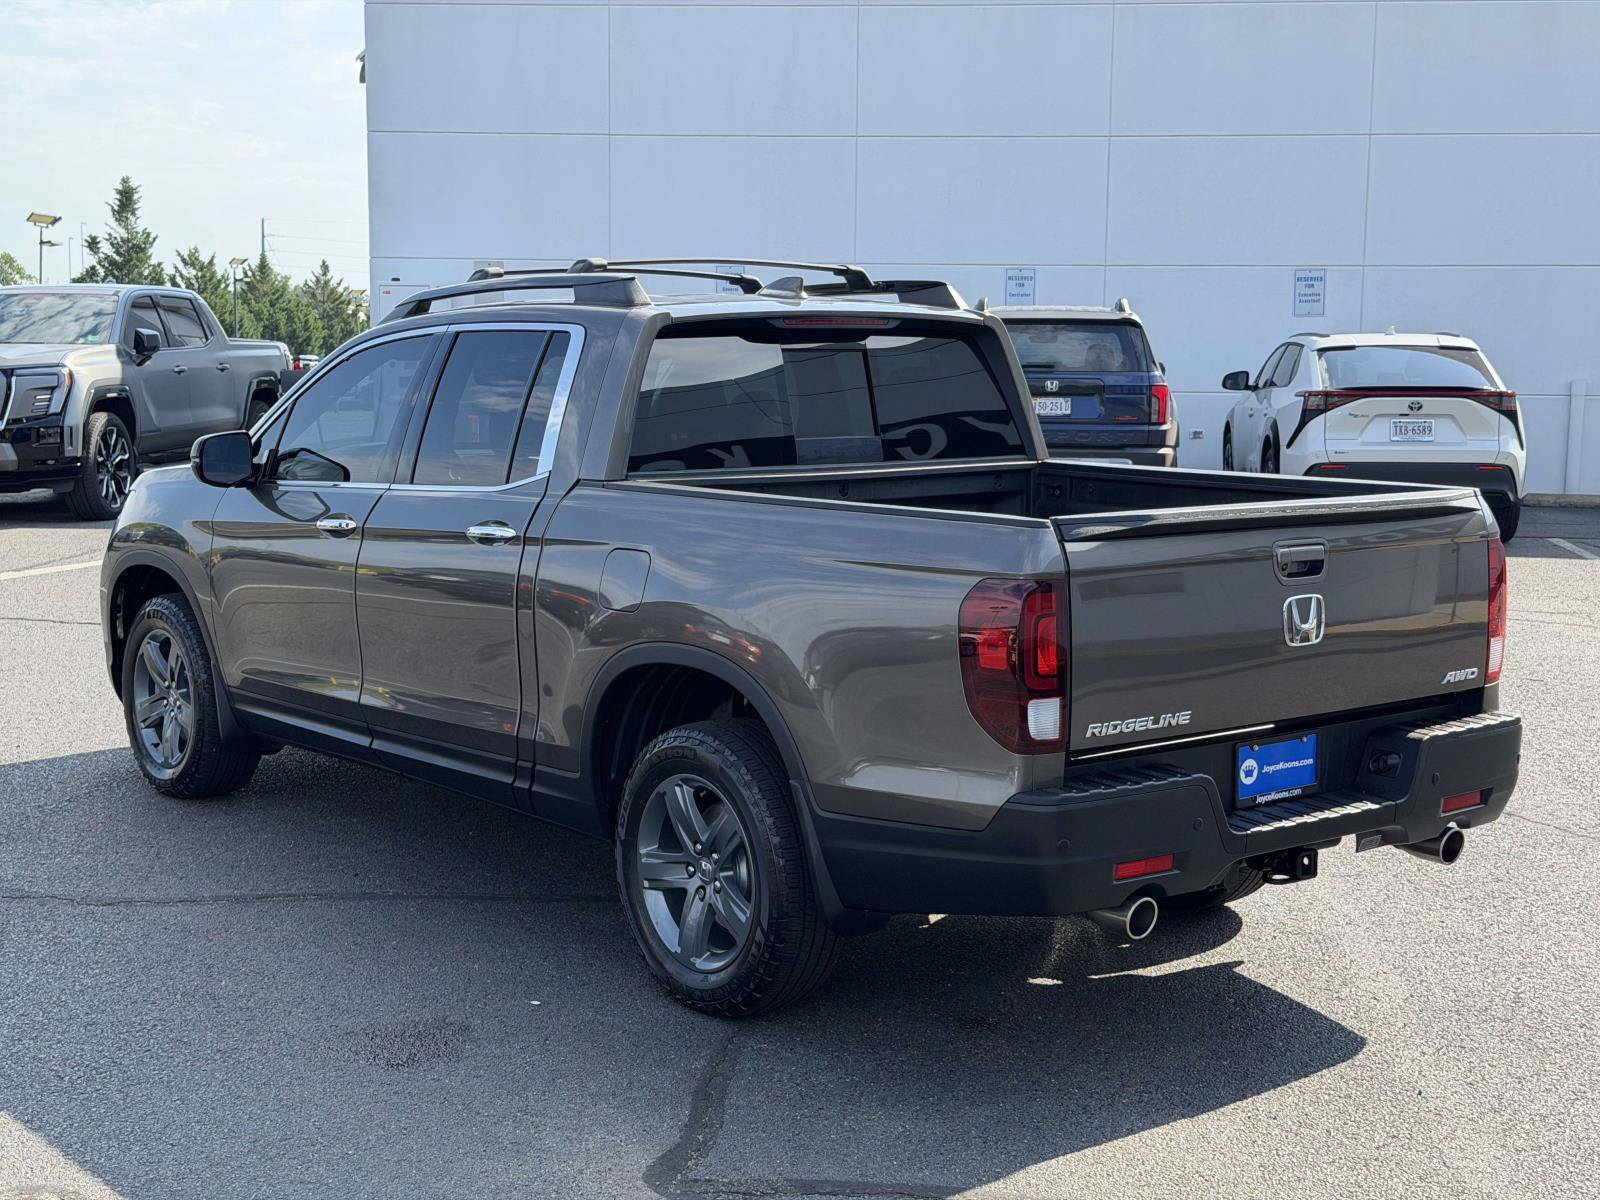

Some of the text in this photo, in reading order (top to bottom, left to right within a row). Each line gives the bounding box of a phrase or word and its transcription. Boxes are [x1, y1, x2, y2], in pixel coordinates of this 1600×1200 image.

[1441, 667, 1479, 685] AWD
[1085, 710, 1193, 738] RIDGELINE
[1261, 758, 1314, 775] JoyceKoons.com
[1255, 787, 1302, 804] JoyceKoons.com
